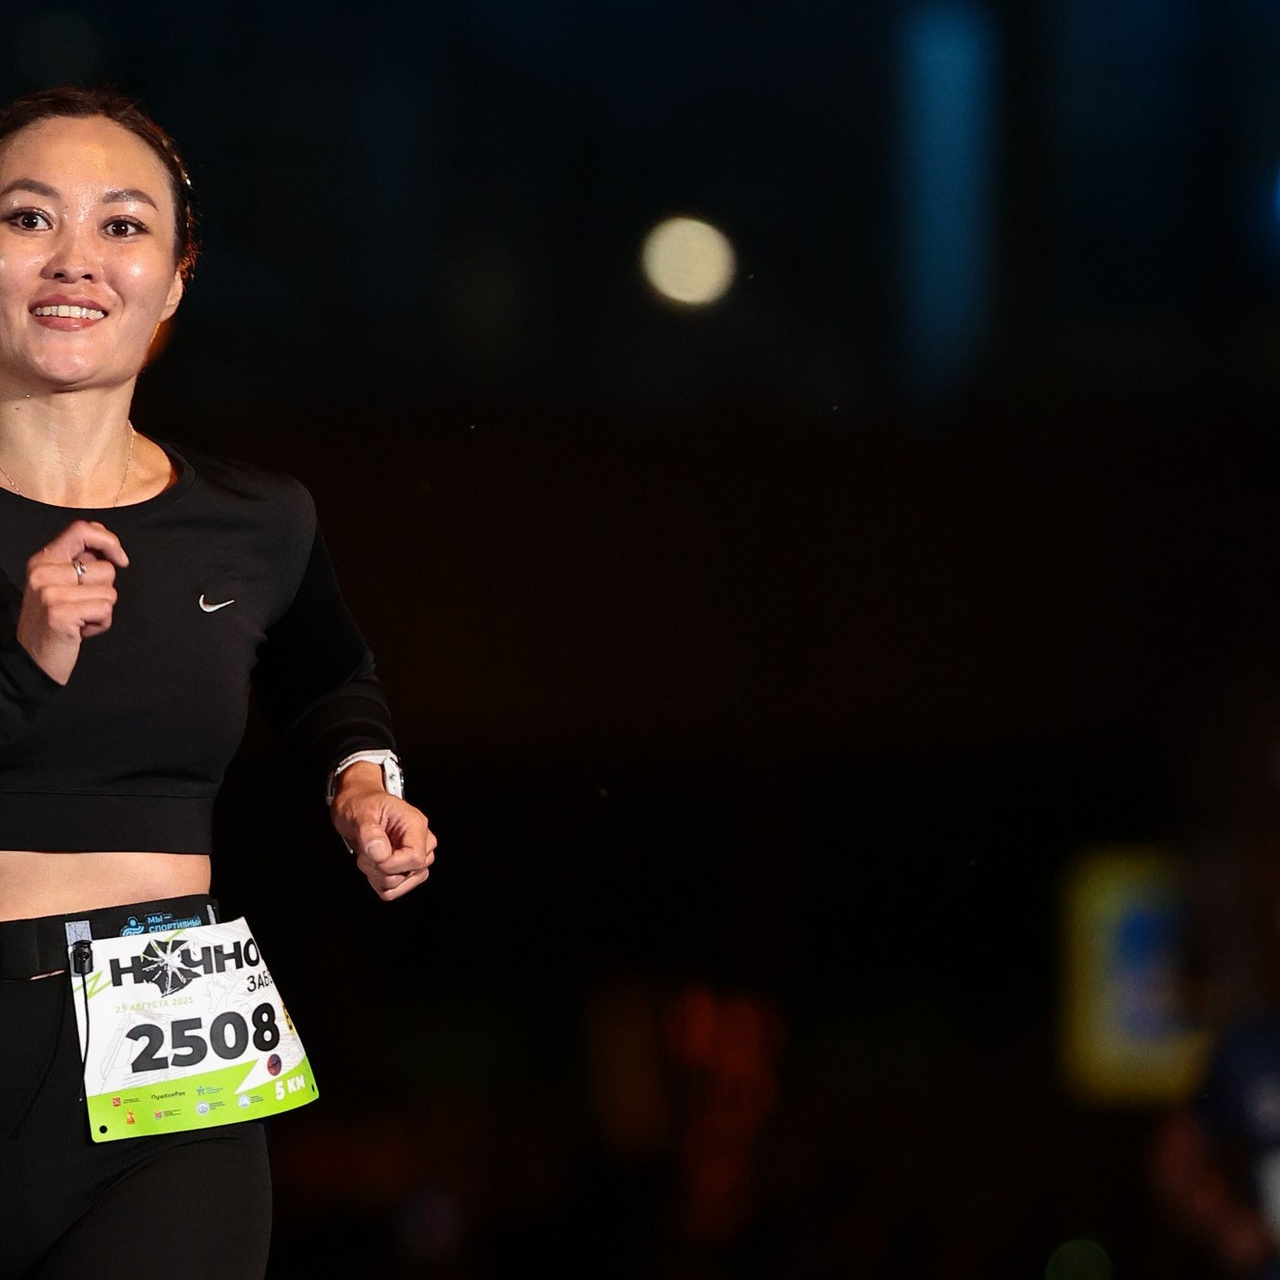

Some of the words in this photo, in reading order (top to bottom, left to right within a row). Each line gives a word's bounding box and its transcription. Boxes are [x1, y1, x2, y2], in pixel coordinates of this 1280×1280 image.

[131, 1000, 169, 1011] АВГУСТА
[125, 1002, 280, 1073] 2508
[275, 1080, 286, 1101] 5
